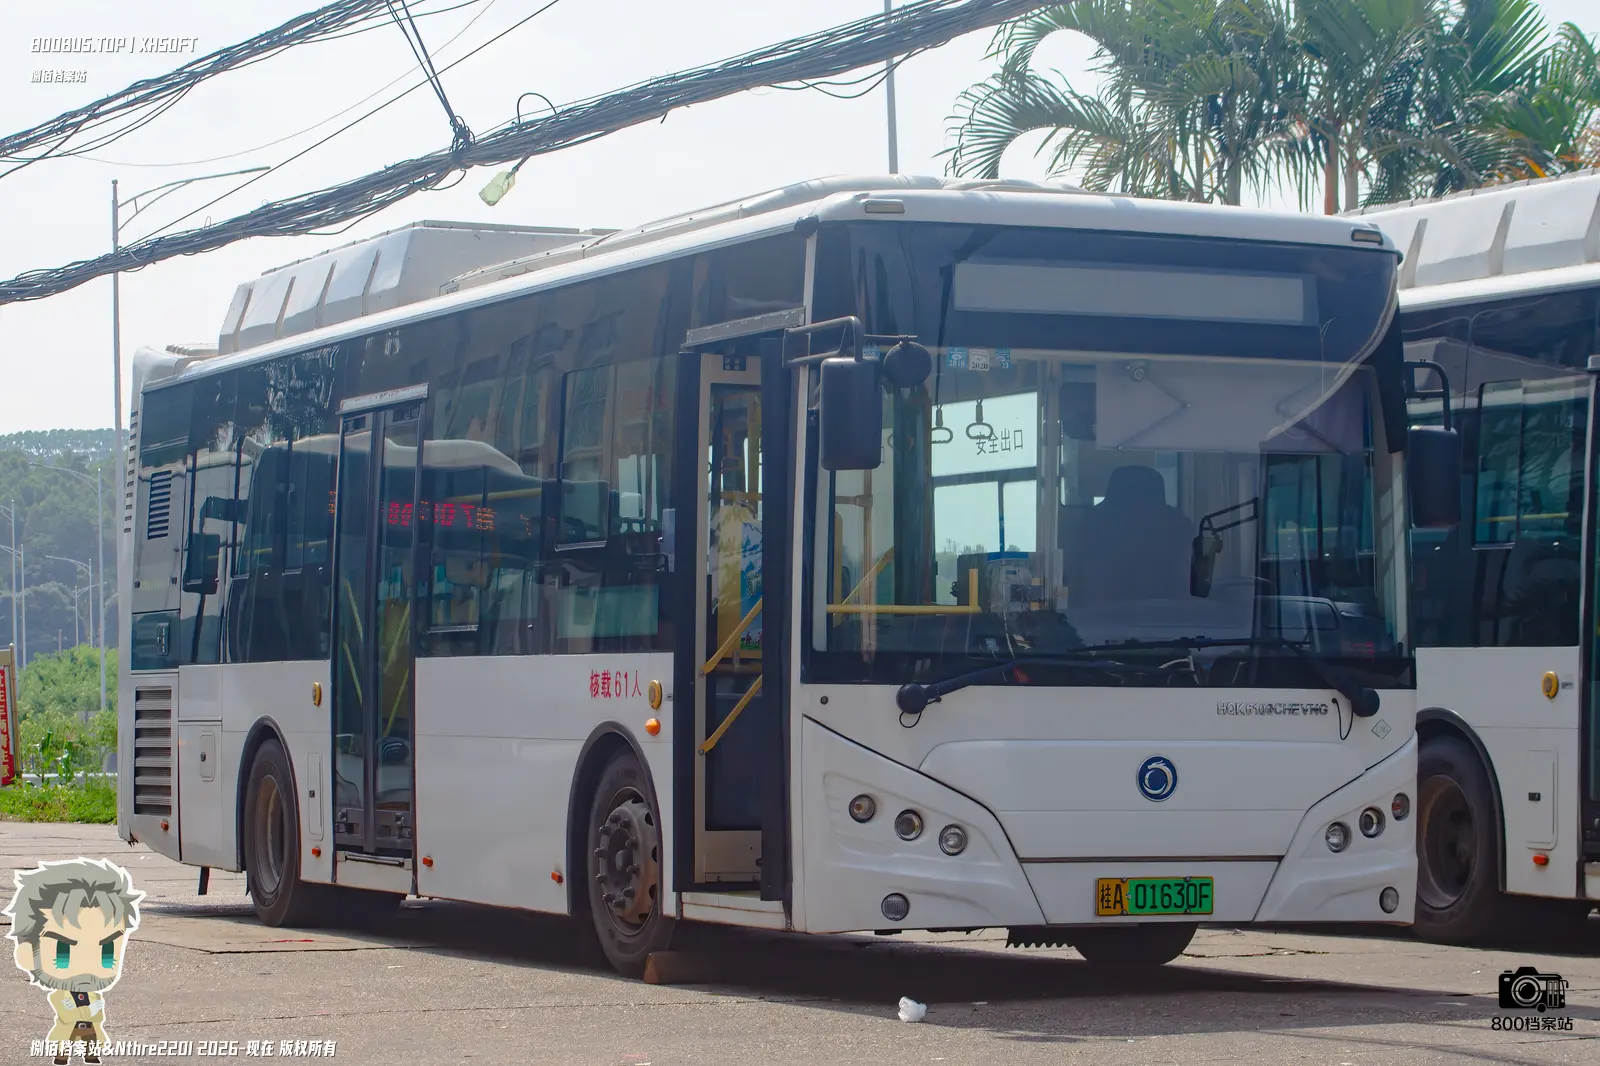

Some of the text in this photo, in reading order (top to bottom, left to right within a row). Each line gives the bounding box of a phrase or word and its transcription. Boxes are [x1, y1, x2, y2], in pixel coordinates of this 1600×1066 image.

[971, 361, 988, 370] 2020
[976, 428, 1024, 455] 安全出口
